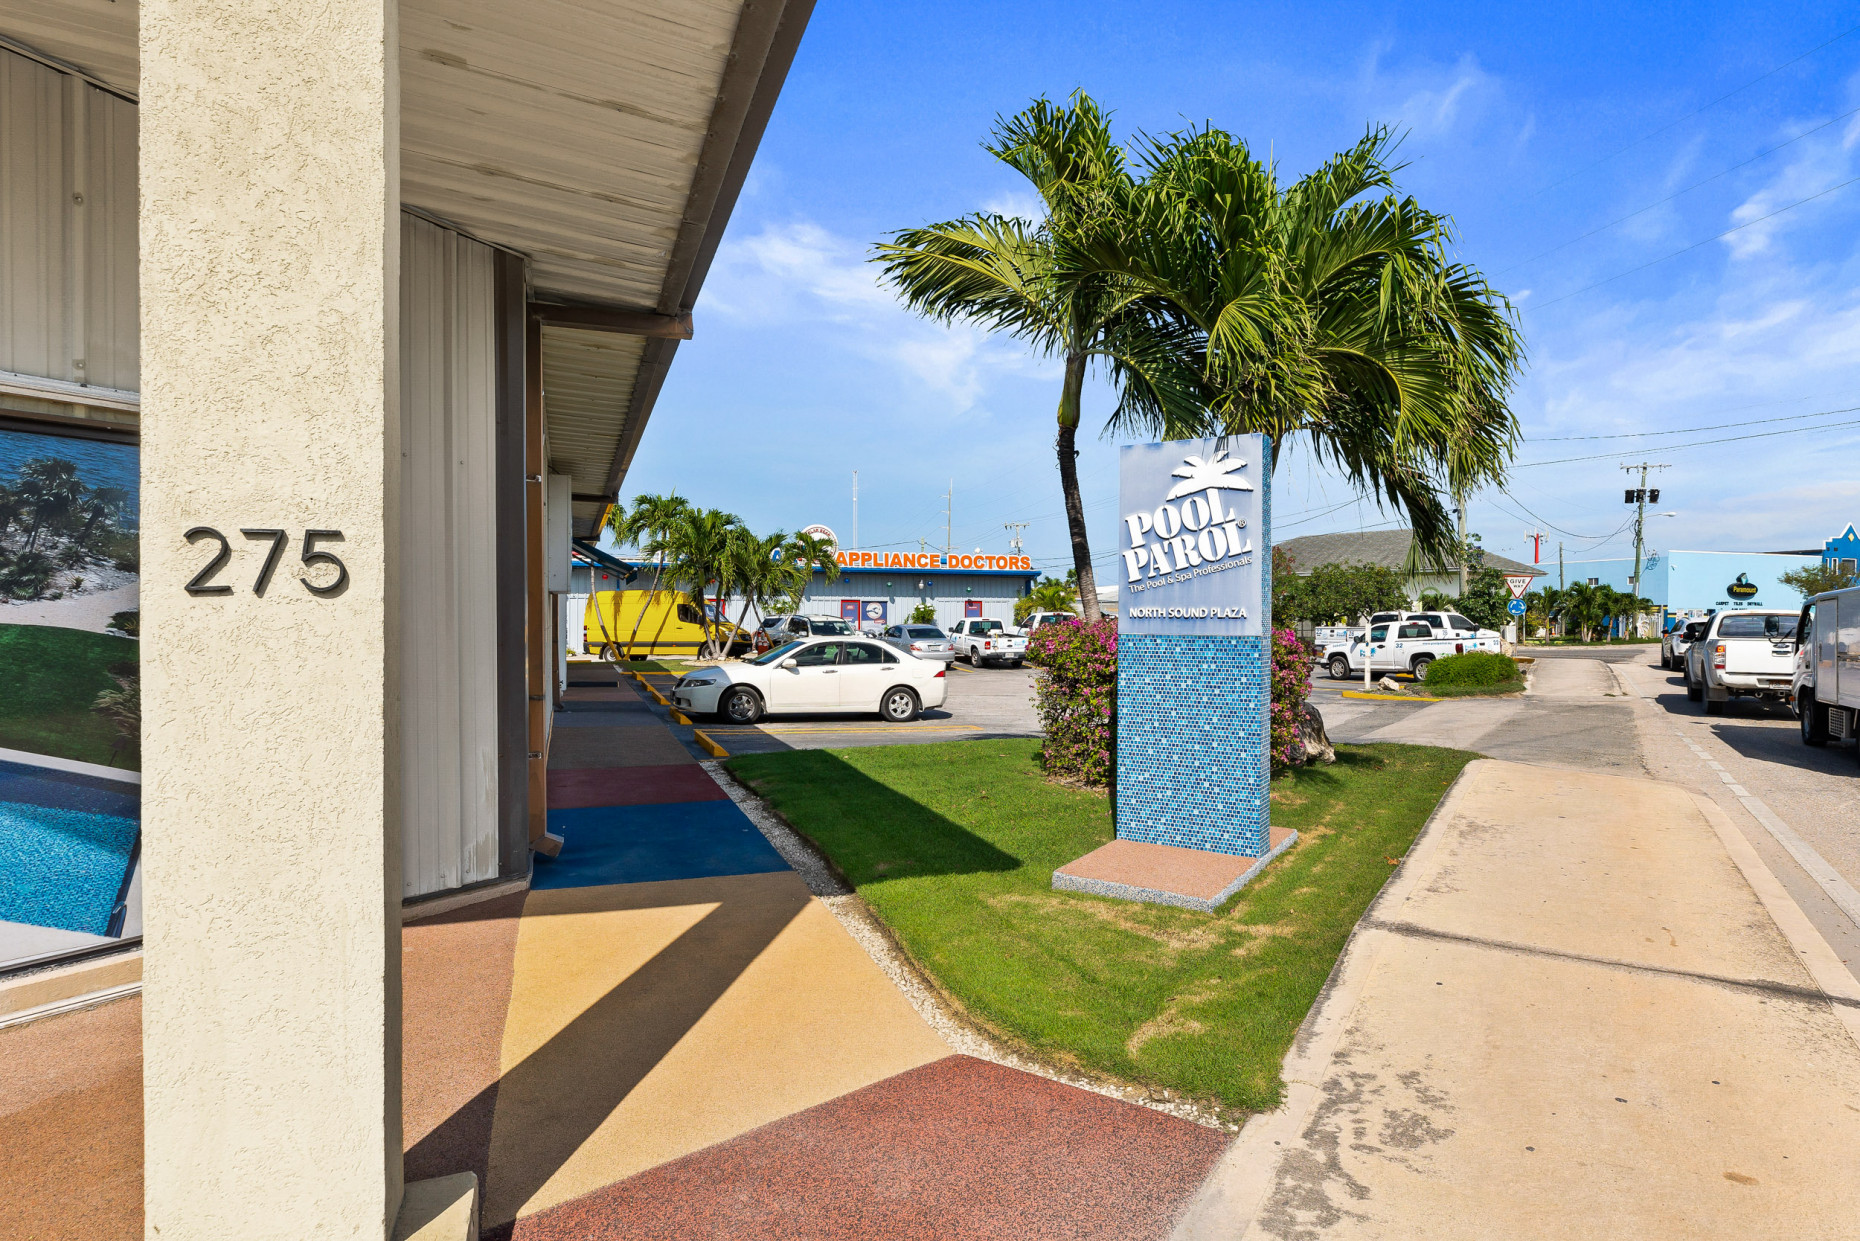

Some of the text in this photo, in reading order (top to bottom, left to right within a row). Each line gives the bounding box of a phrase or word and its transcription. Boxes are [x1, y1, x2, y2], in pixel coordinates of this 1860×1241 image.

[1125, 489, 1236, 549] POOL
[183, 526, 349, 599] 275
[836, 551, 1032, 570] APPLIANCE DOCTORS
[1122, 521, 1253, 583] PATROL
[1128, 556, 1253, 594] The Pool & Spa Professionals
[1732, 585, 1757, 593] Paramount
[1129, 607, 1247, 620] NORTH SOUND PLAZA
